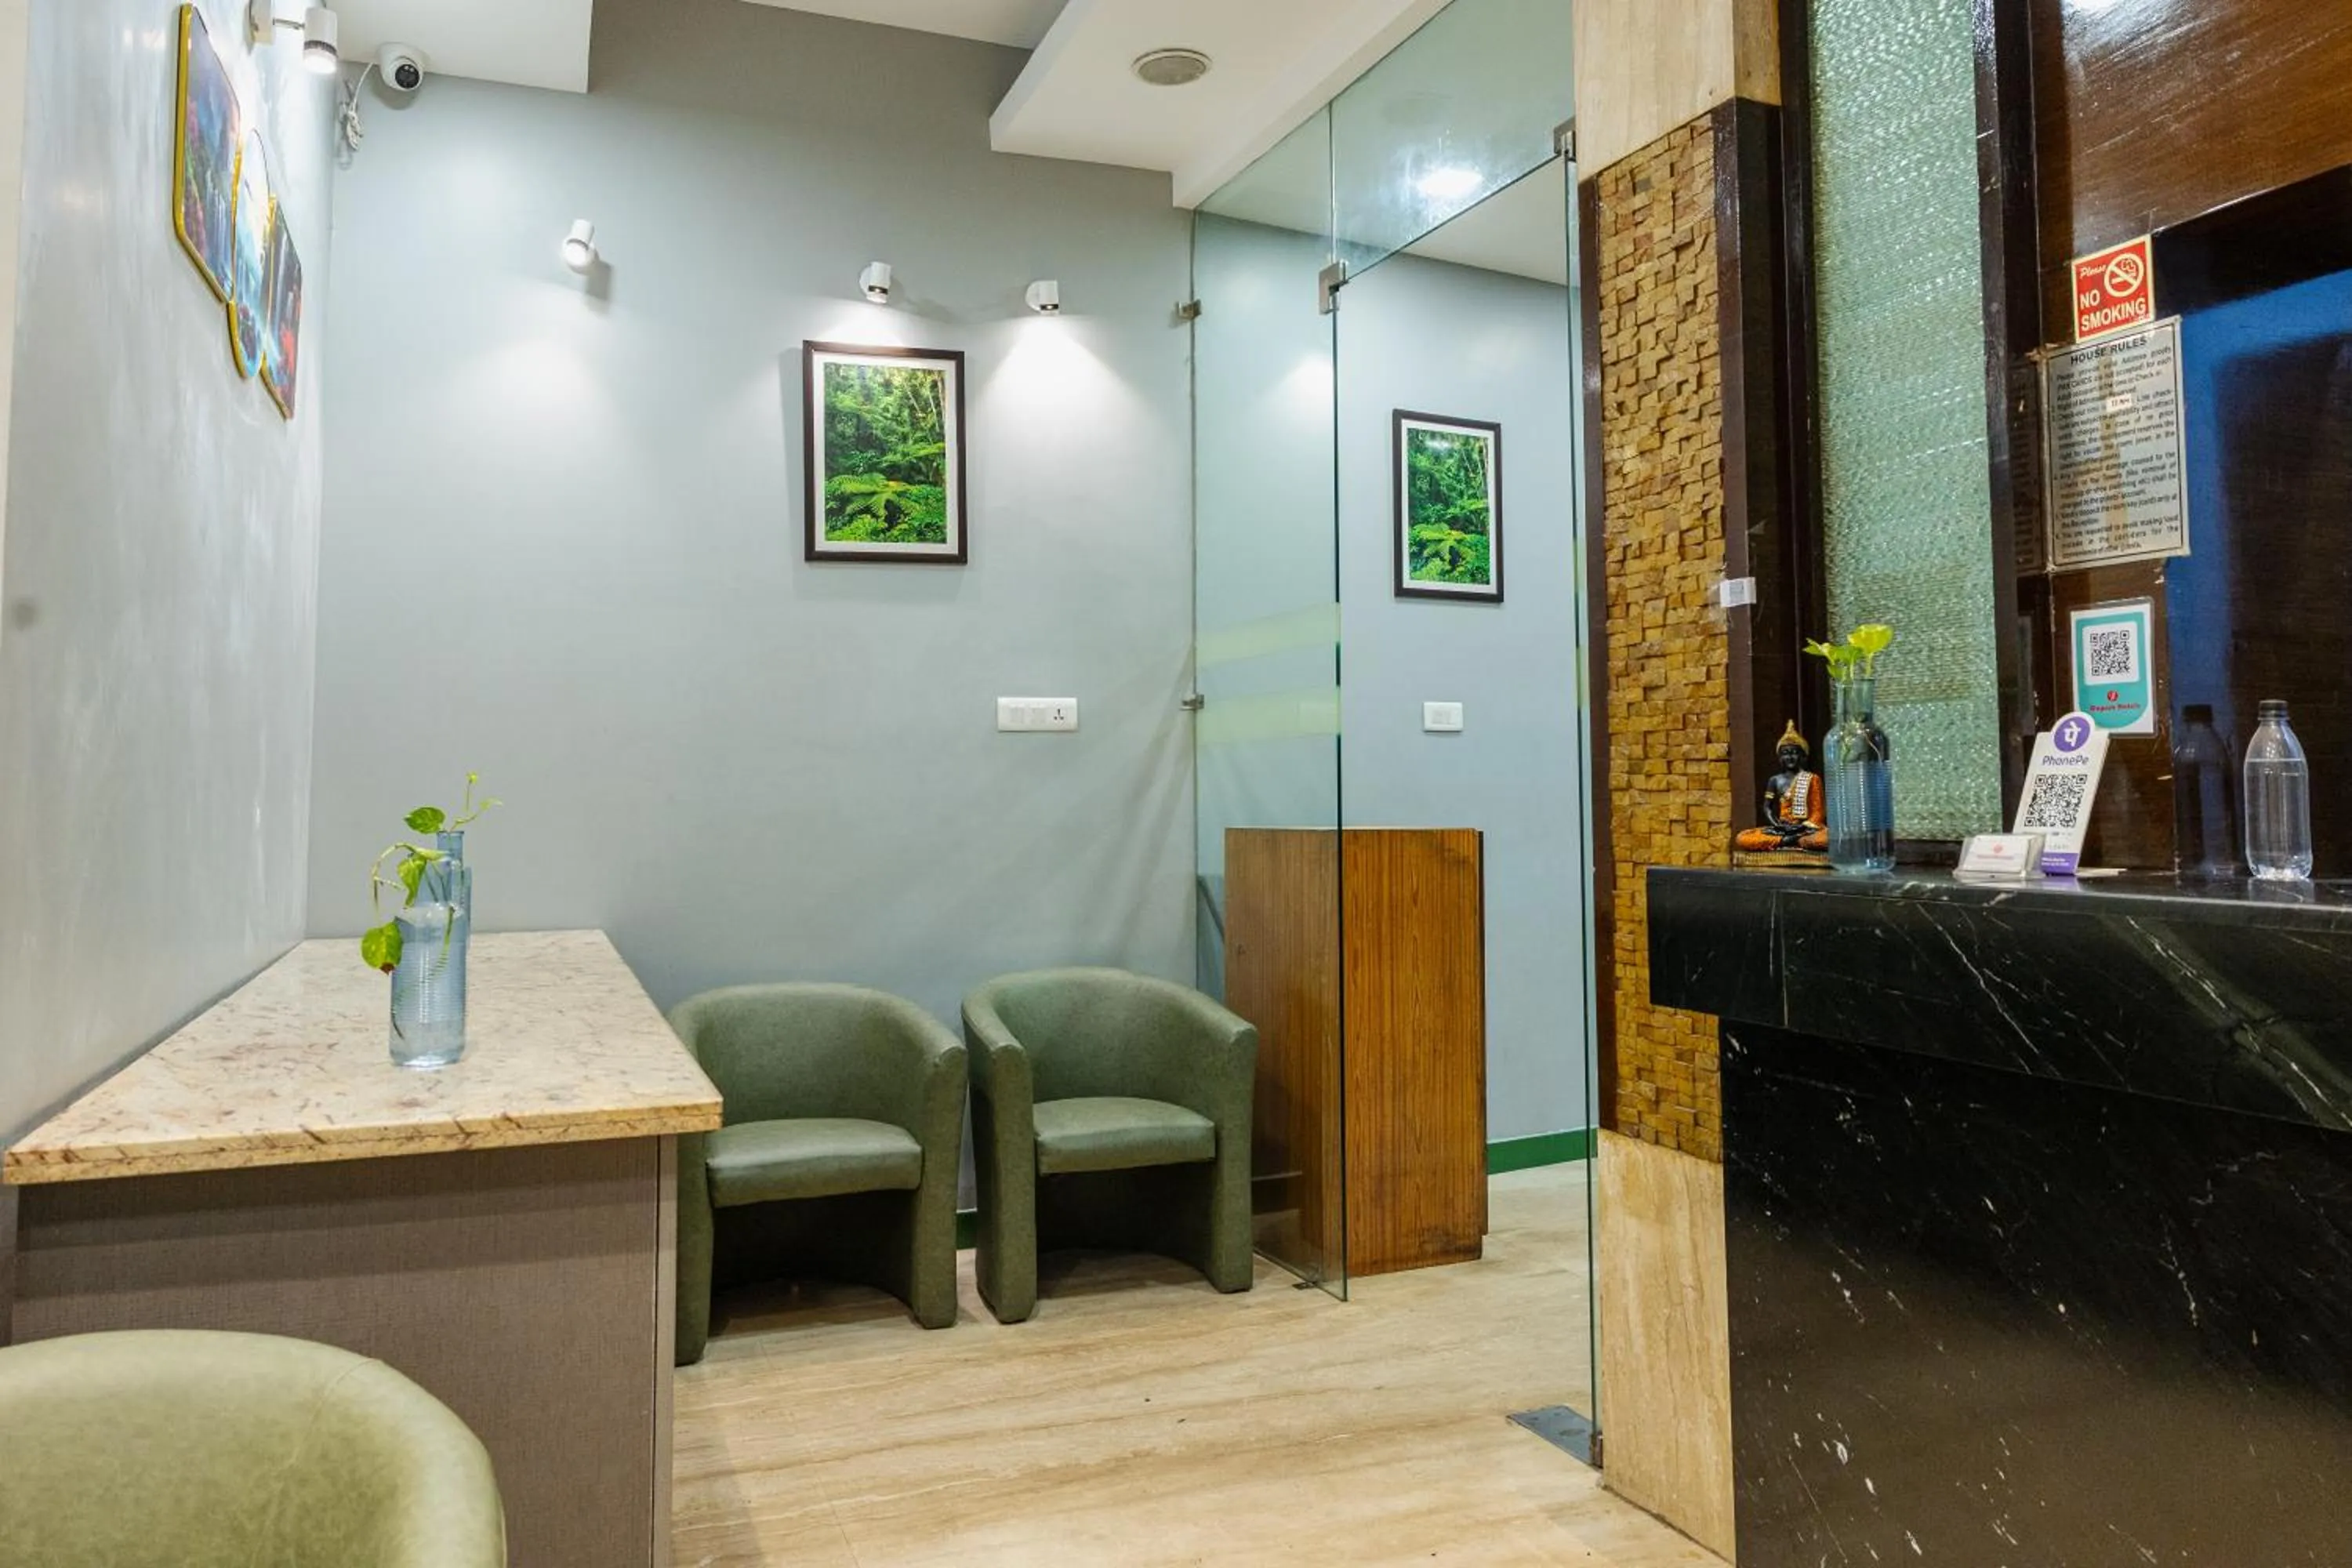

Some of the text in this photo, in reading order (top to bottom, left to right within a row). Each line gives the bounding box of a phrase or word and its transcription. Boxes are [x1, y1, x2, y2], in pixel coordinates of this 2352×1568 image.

[2080, 264, 2107, 279] Please
[2079, 289, 2100, 310] NO
[2082, 297, 2147, 331] SMOKING
[2070, 334, 2147, 365] HOUSE RULES
[2063, 720, 2082, 747] पे
[2042, 754, 2089, 766] PhonePe
